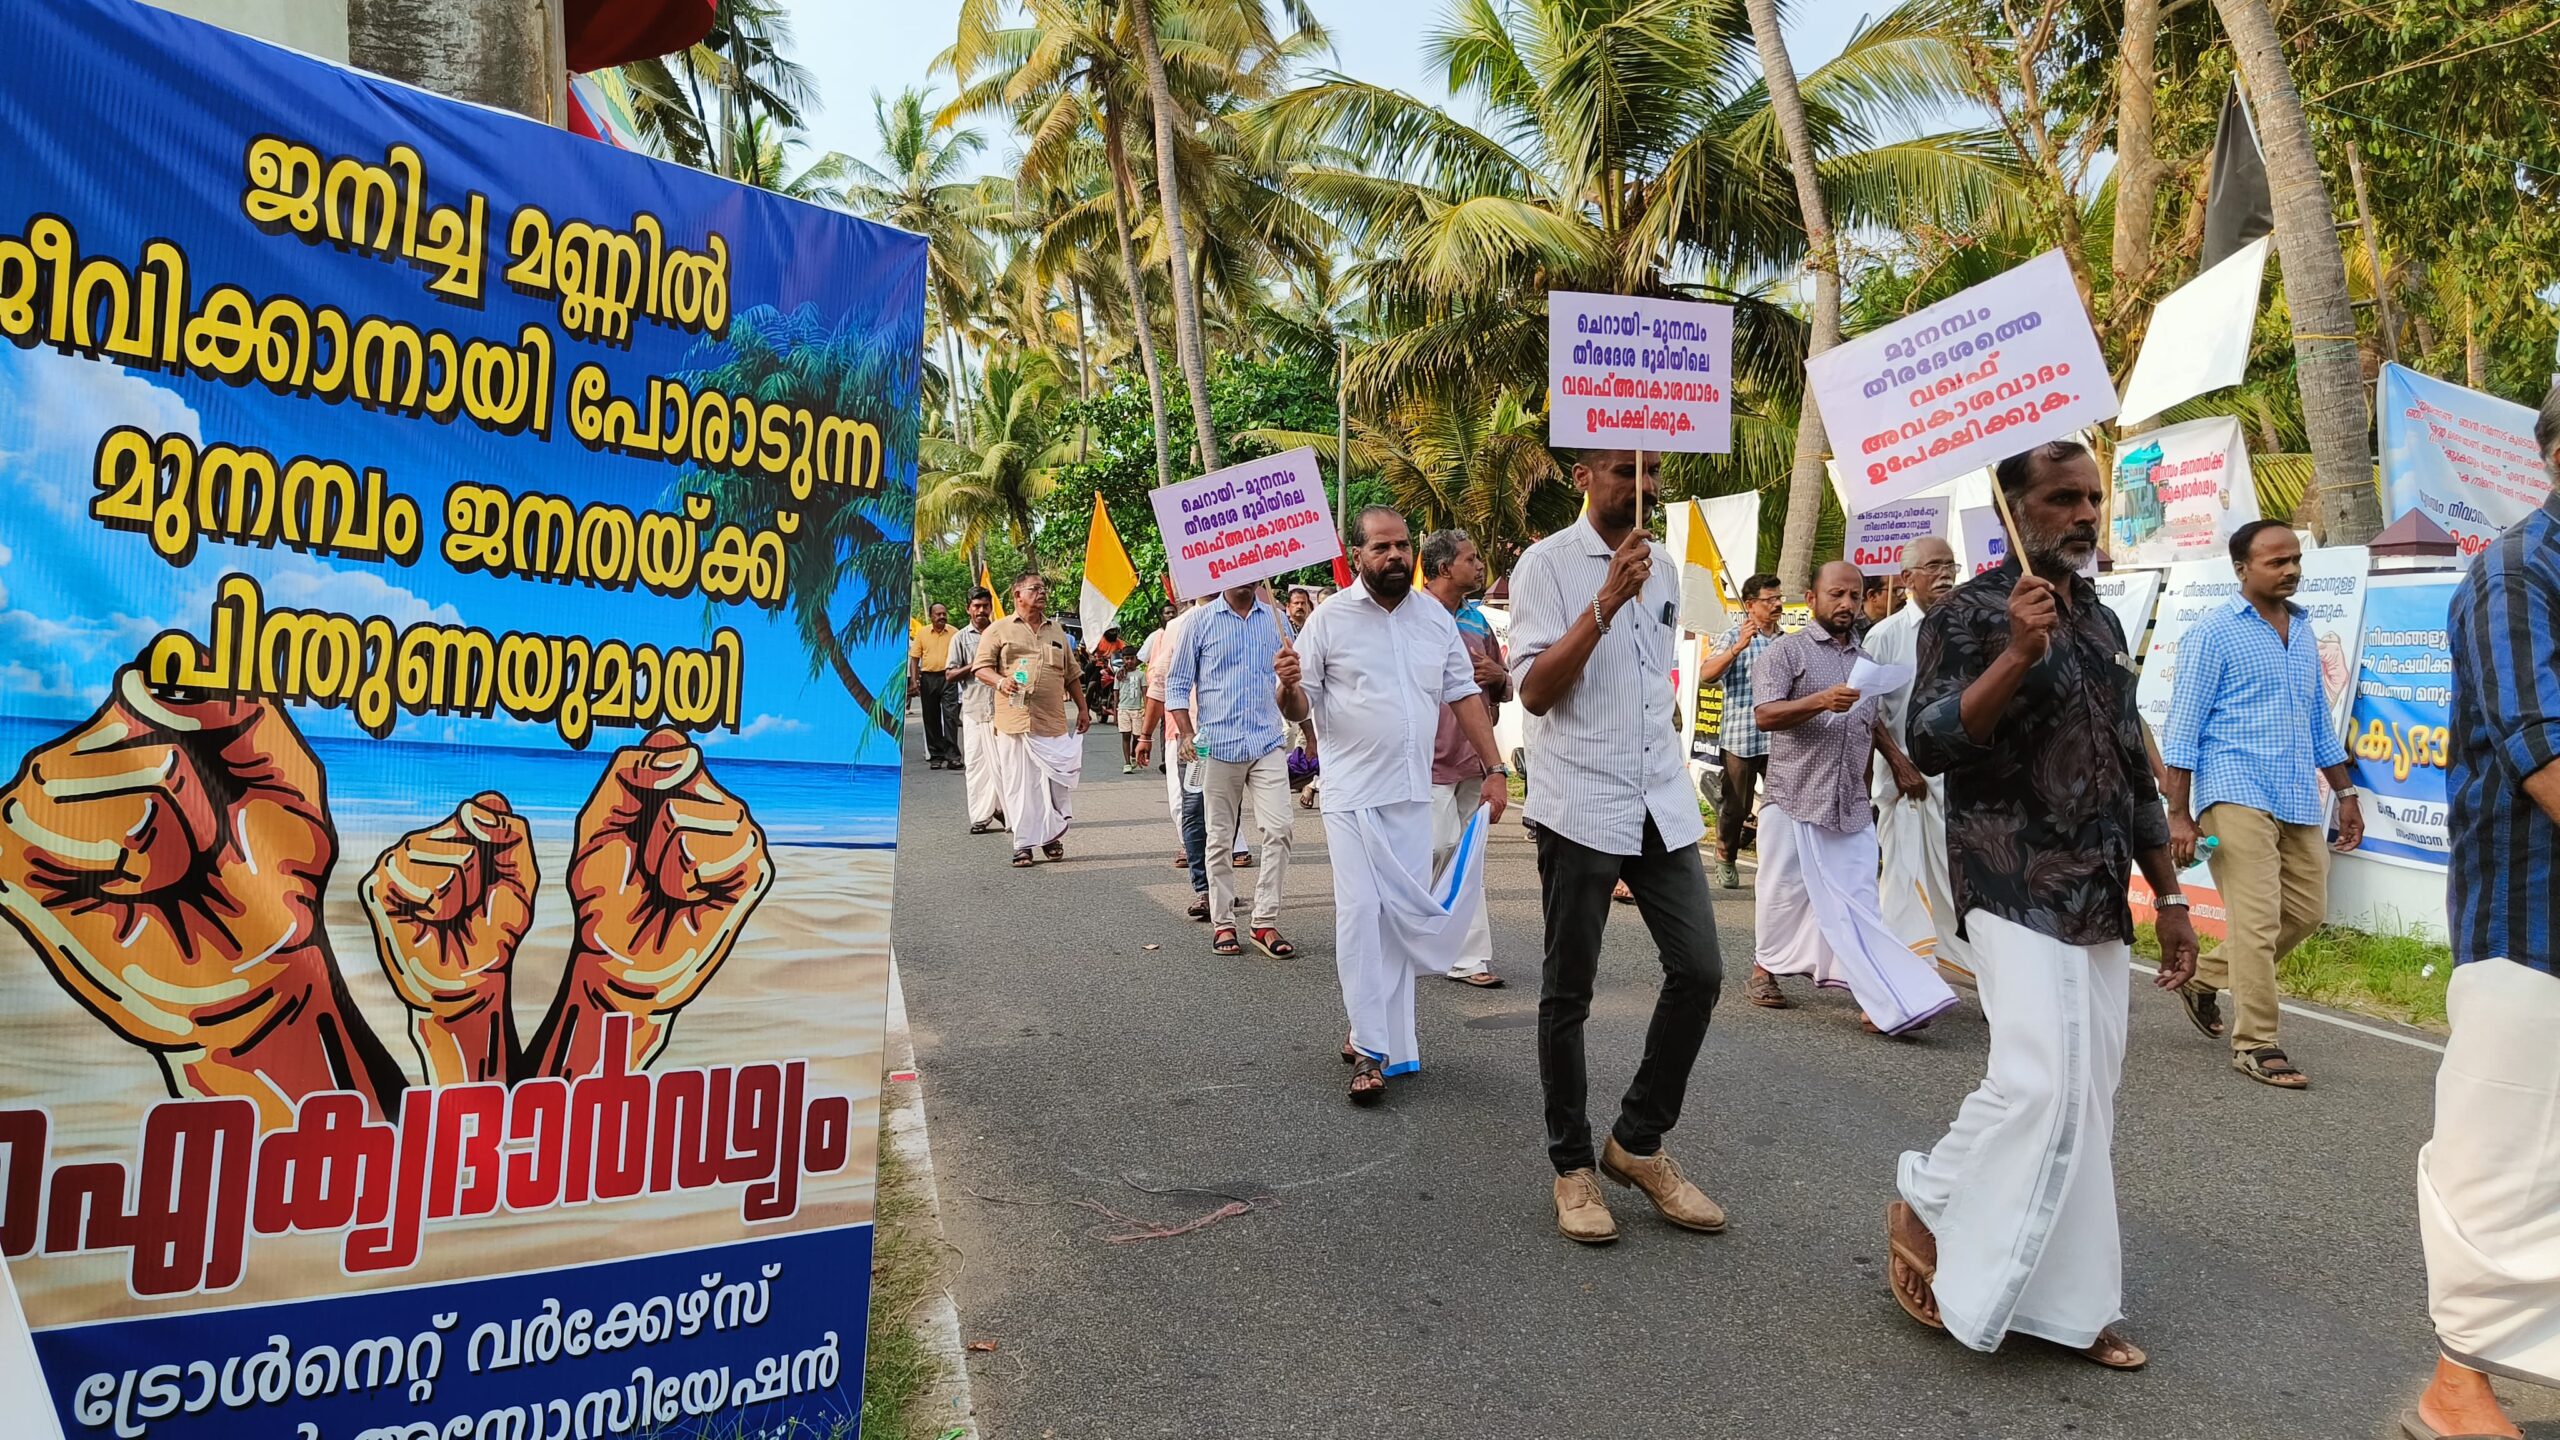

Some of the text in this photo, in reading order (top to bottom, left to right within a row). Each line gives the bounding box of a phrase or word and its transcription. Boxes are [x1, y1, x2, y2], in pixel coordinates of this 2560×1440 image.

[246, 138, 728, 339] ജനിച്ച മണ്ണിൽ
[1573, 339, 1636, 368] തീരദേശ
[1863, 311, 2042, 399] തീരദേശത്തെ
[1885, 307, 1991, 361] മുനമ്പം
[1586, 404, 1696, 437] ഉപേക്ഷിക്കുക.
[1861, 363, 2071, 455] അവകാശവാദം
[1909, 351, 2000, 408] വഖഫ്
[570, 366, 881, 500] പോരാടുന്ന
[1866, 391, 2080, 486] ഉപേക്ഷിക്കുക.
[95, 430, 799, 600] മുനമ്പം ജനതയ്ക്ക്
[1184, 507, 1239, 536] തീരദേശ
[1207, 537, 1305, 580] ഉപേക്ഷിക്കുക.
[149, 576, 740, 742] പിന്തുണയുമായി
[74, 1262, 783, 1436] ട്രോൾനെറ്റ് വർക്കേഴ്സ്
